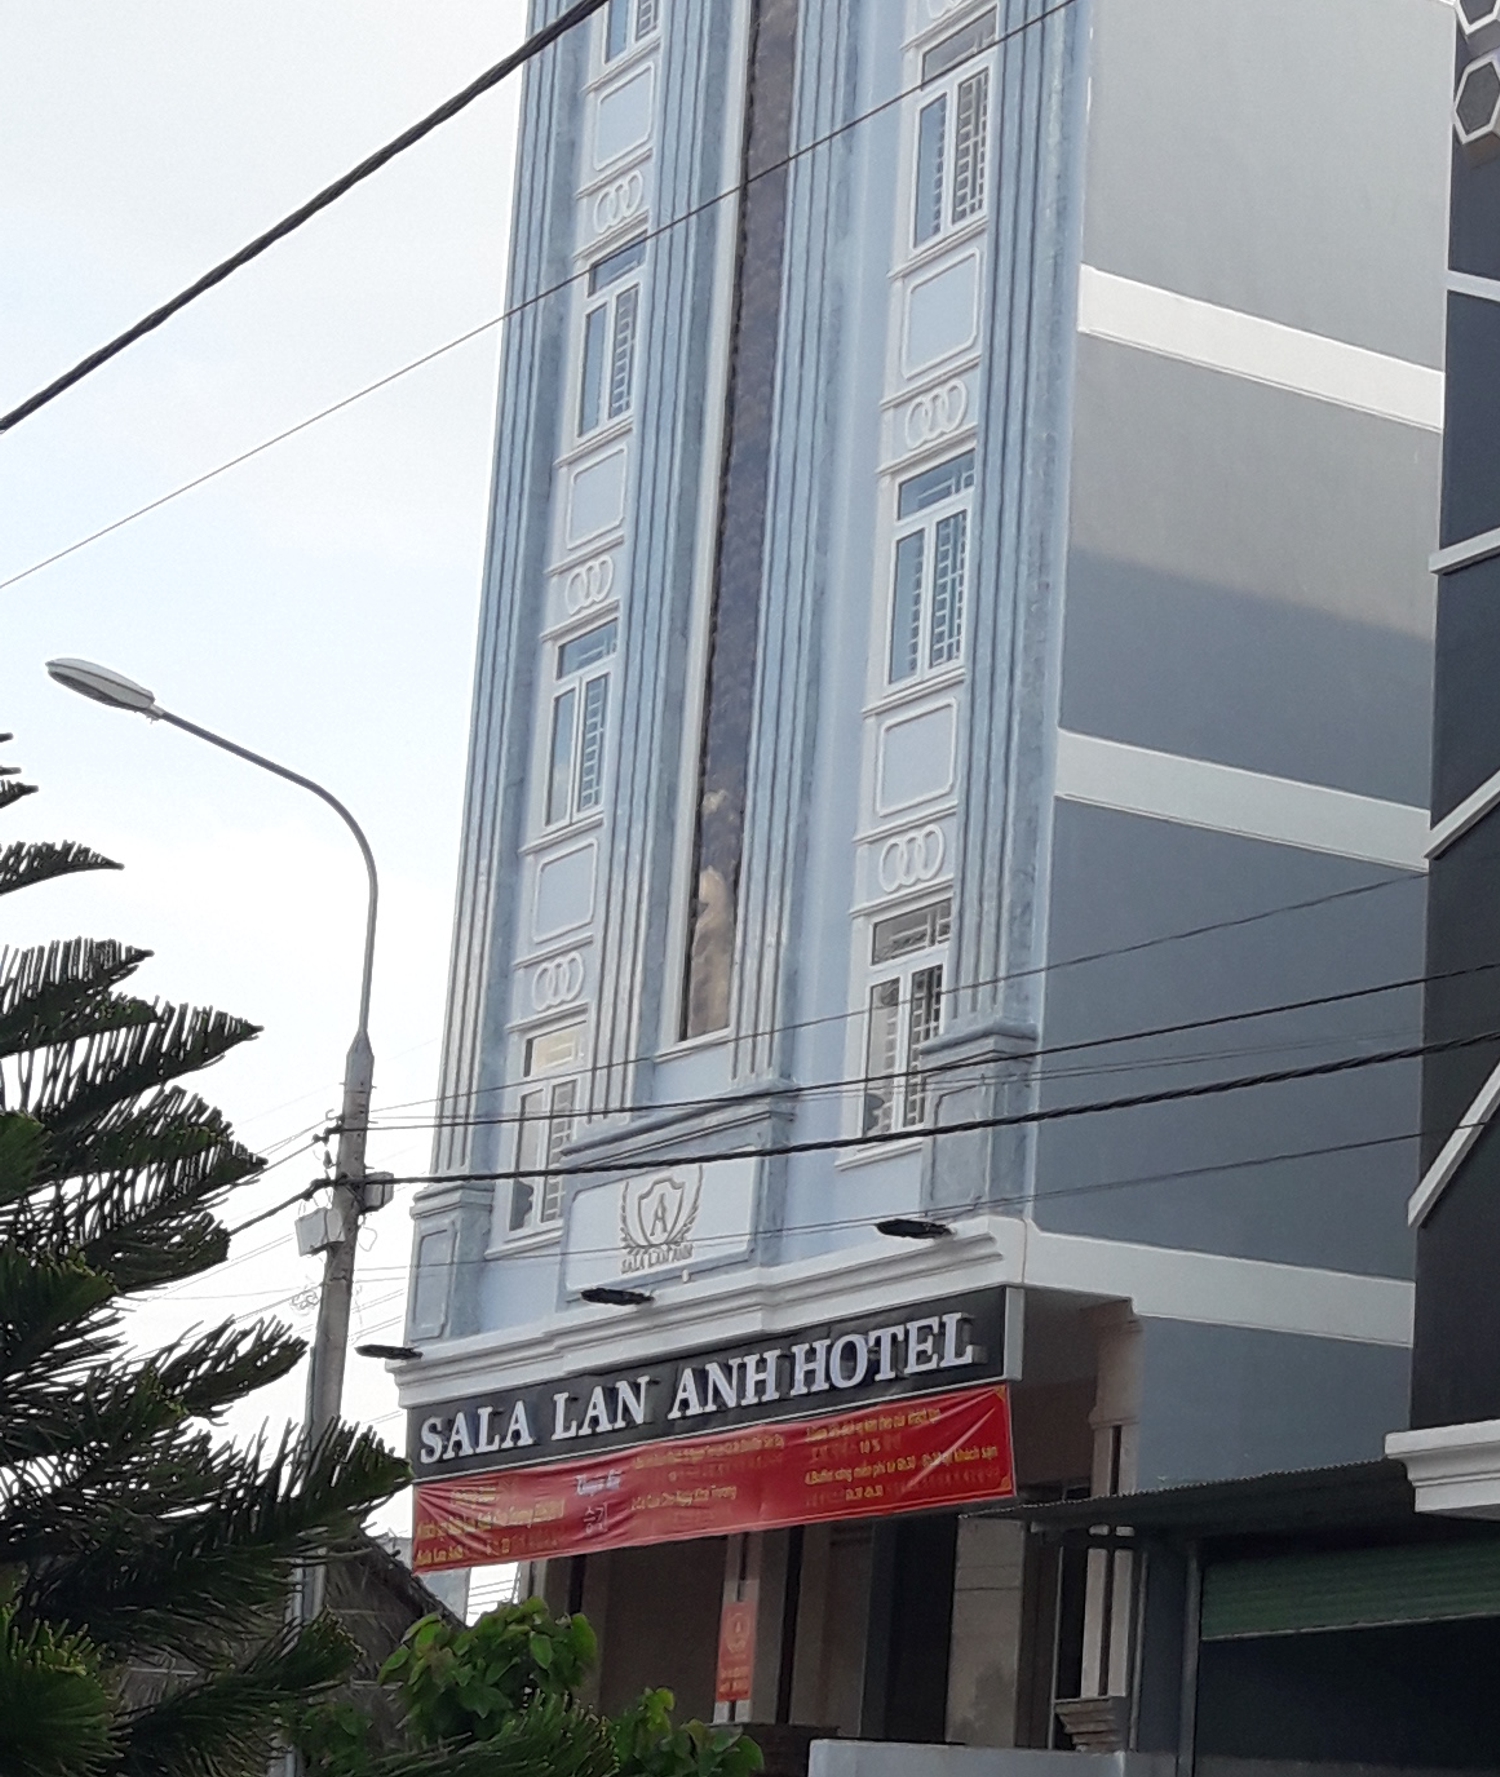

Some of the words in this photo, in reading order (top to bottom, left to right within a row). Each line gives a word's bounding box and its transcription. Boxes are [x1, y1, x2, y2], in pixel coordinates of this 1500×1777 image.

[420, 1400, 535, 1464] SALA
[551, 1375, 650, 1441] LAN
[667, 1347, 781, 1420] ANH
[790, 1312, 975, 1397] HOTEL
